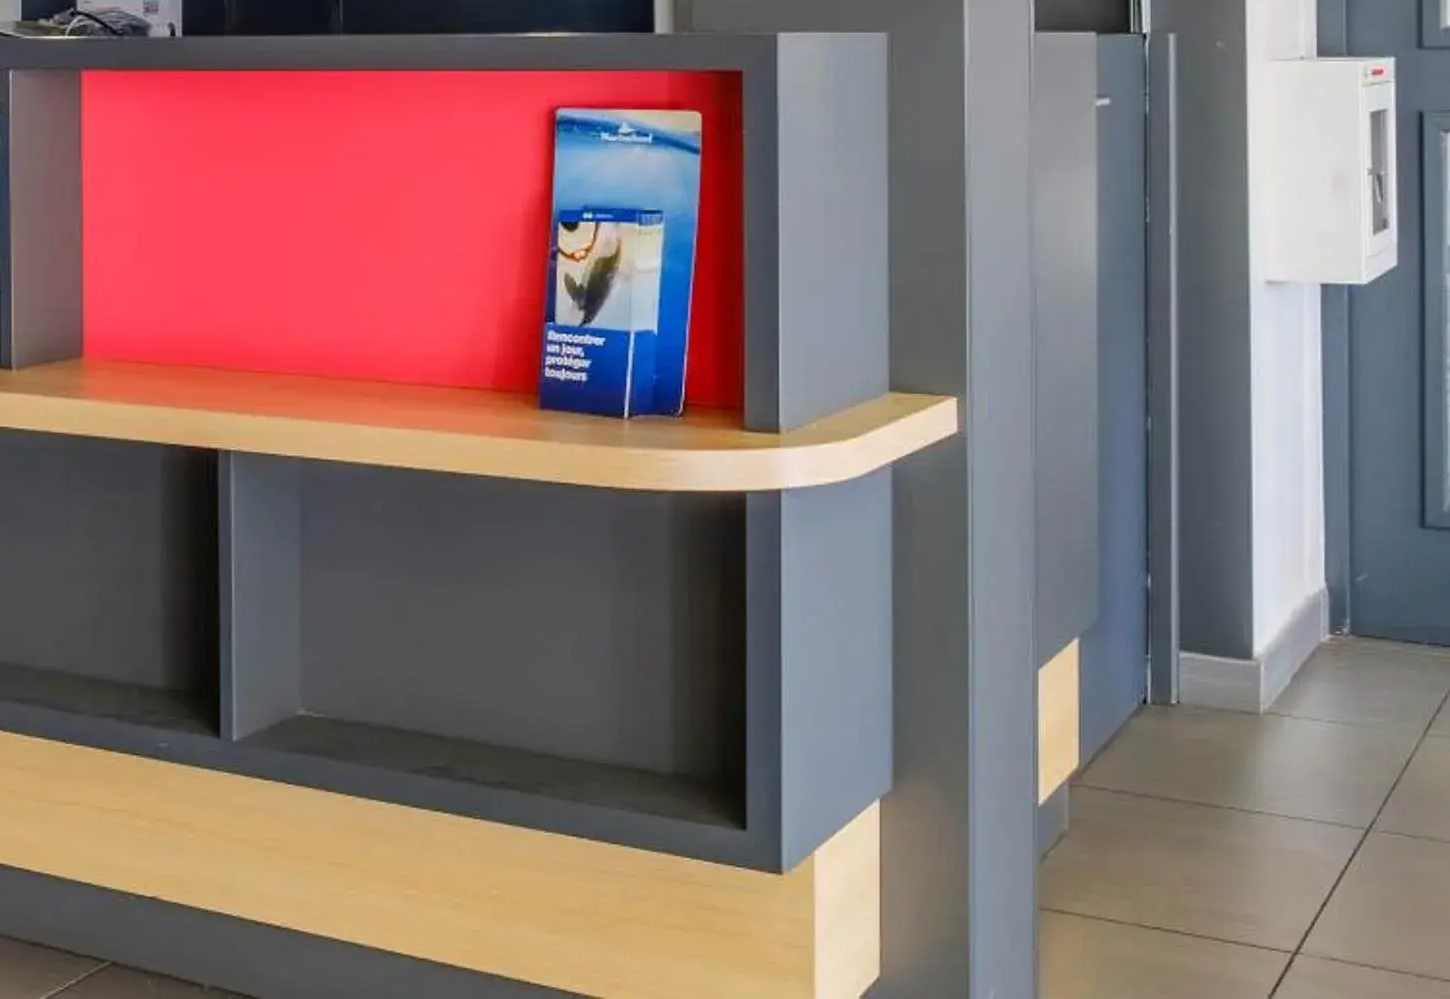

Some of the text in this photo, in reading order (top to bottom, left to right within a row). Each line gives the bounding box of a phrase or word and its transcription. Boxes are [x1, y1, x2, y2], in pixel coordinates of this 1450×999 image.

[547, 330, 606, 346] Rencontrer
[547, 344, 559, 354] un
[545, 355, 592, 369] protéger
[545, 366, 588, 382] toujours
